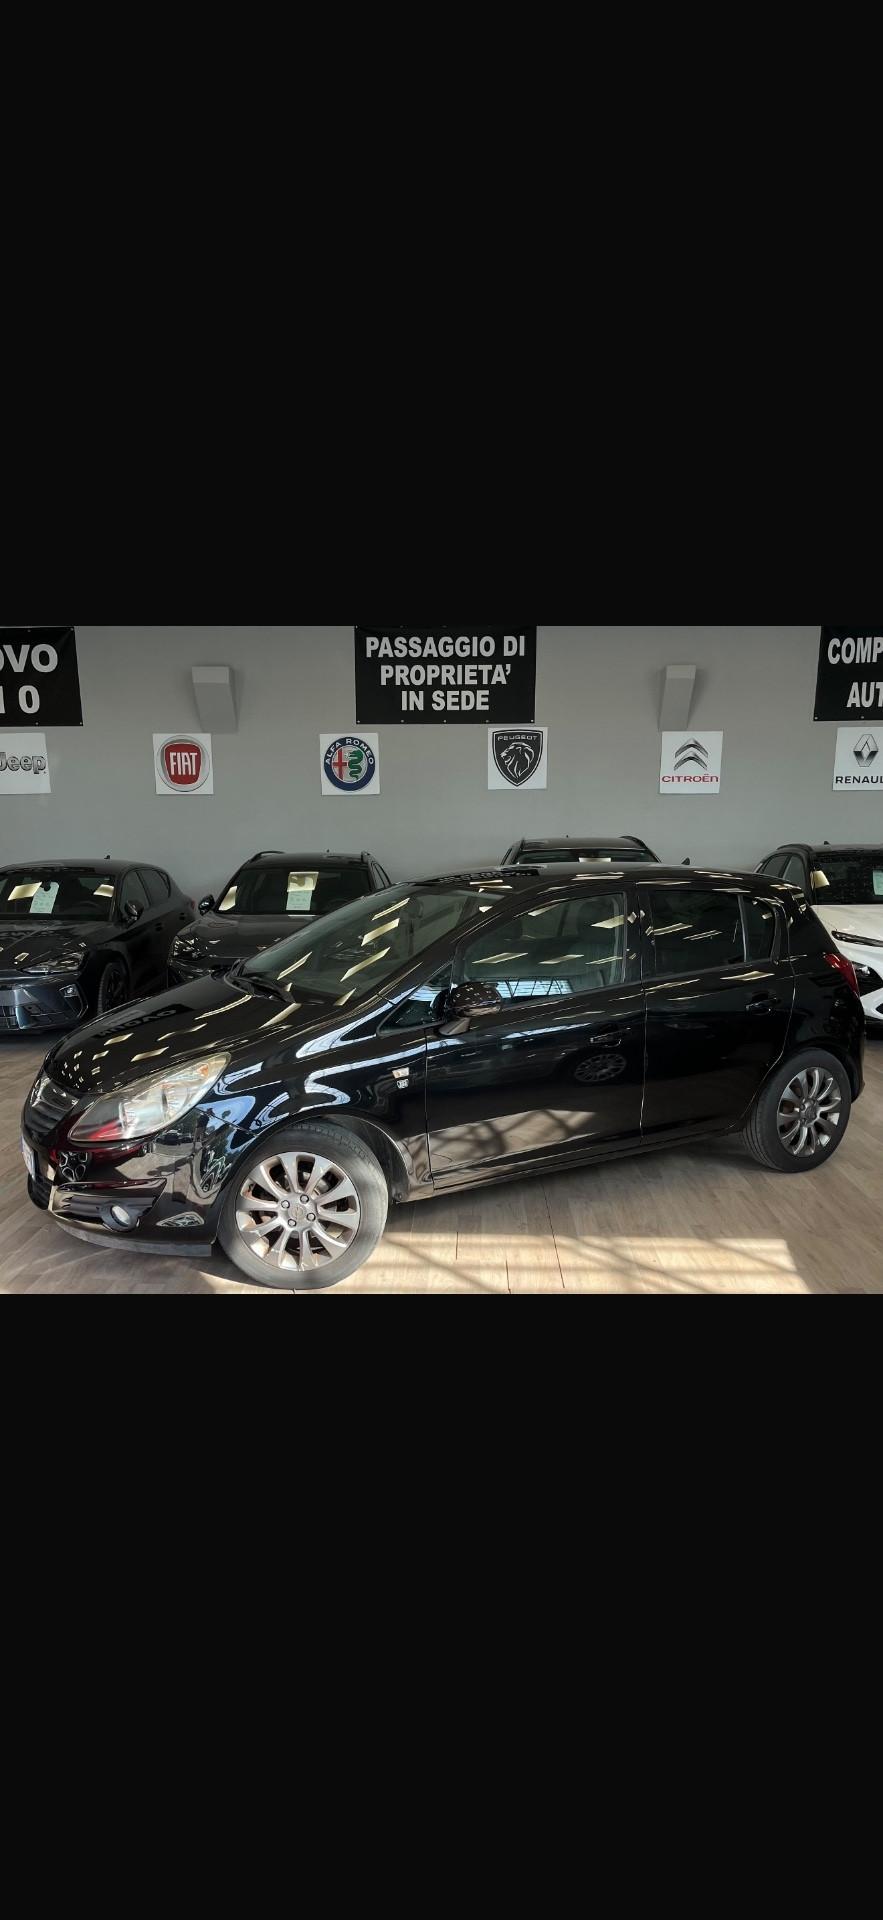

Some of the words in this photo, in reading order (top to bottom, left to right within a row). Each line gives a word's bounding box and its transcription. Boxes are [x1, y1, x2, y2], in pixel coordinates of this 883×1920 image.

[0, 644, 58, 673] VO
[366, 636, 495, 658] PASSAGGIO
[503, 635, 525, 657] DI
[828, 636, 883, 664] COMP
[401, 691, 424, 711] IN
[431, 690, 489, 711] SEDE
[325, 742, 341, 765] ALFA
[345, 738, 374, 765] ROMEO
[169, 752, 198, 776] FIAT
[661, 773, 719, 783] CITROËN
